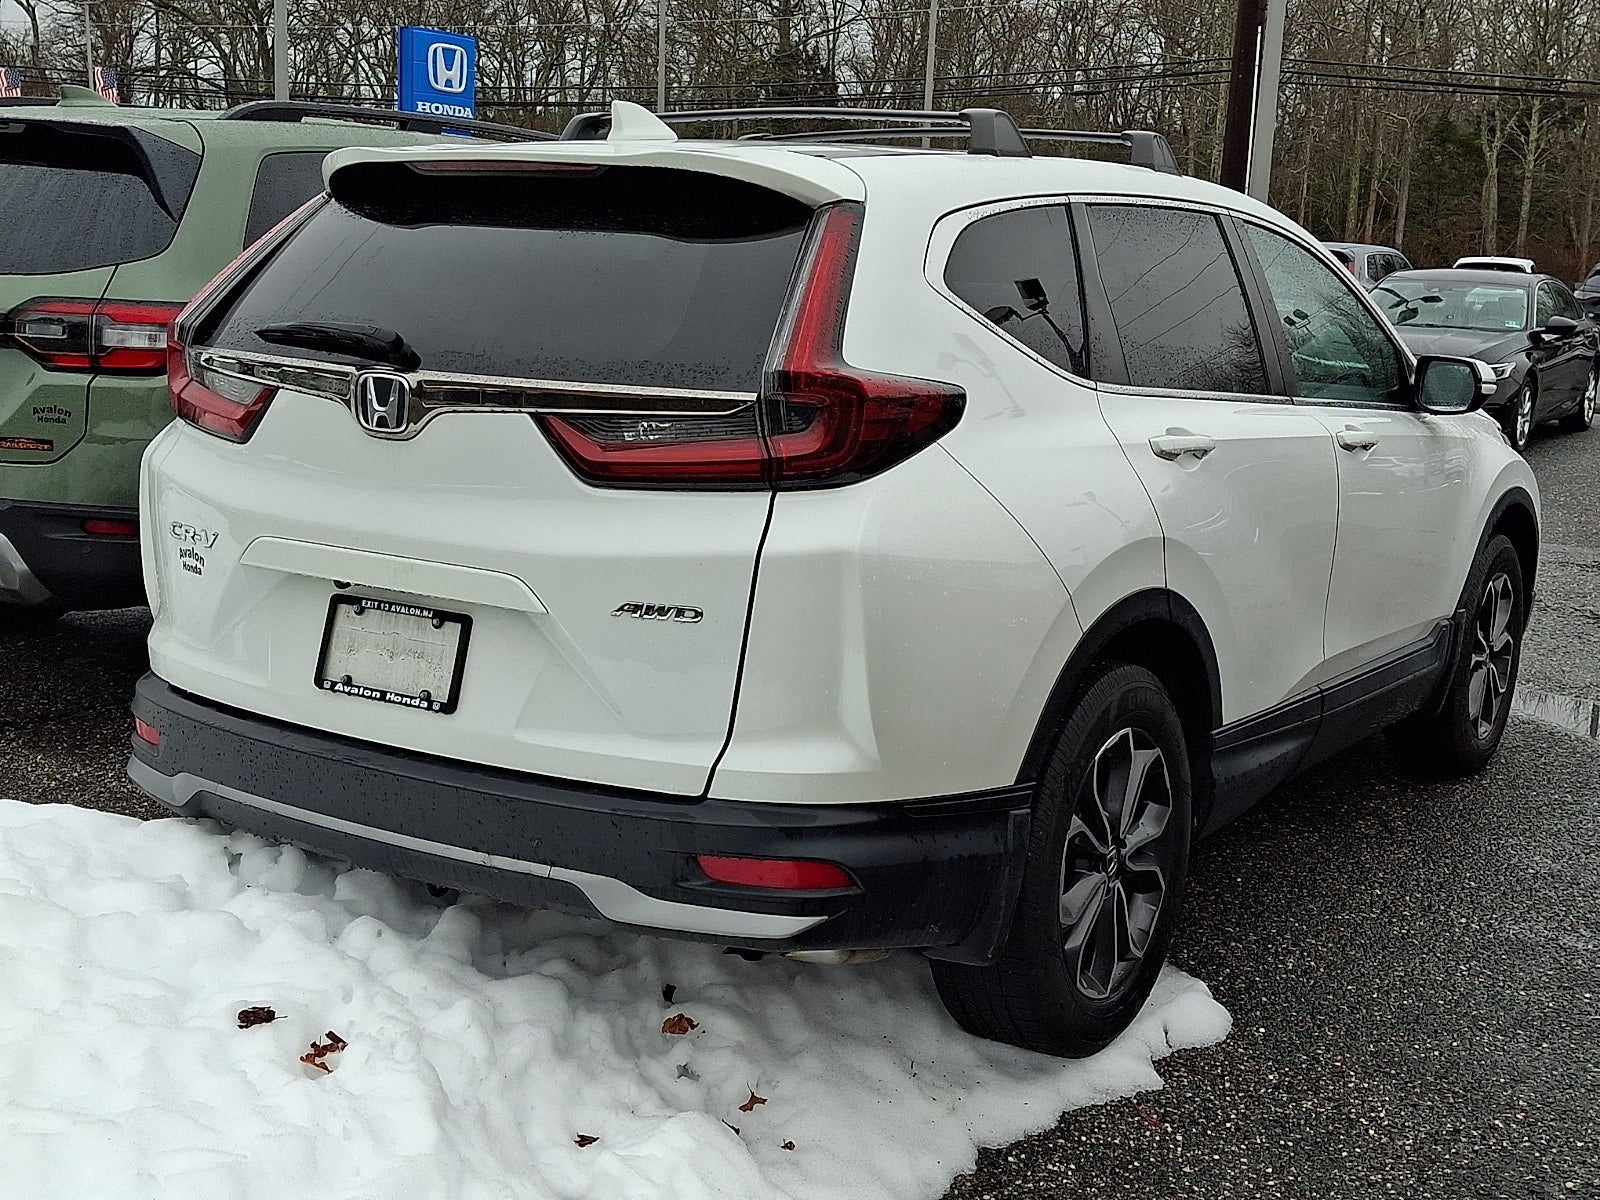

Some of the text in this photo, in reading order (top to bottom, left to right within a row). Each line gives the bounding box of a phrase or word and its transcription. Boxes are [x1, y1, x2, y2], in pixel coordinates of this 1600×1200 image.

[416, 101, 474, 119] HONDA
[32, 405, 72, 418] Avalon
[37, 416, 67, 424] Honda
[0, 440, 52, 450] RAILSPORT
[169, 521, 219, 550] CR-V
[179, 547, 205, 567] Avalon
[182, 561, 203, 576] Honda
[361, 599, 379, 610] EXIT
[380, 601, 390, 611] 13
[610, 600, 704, 623] AWD
[333, 682, 429, 709] Avalon Honda
